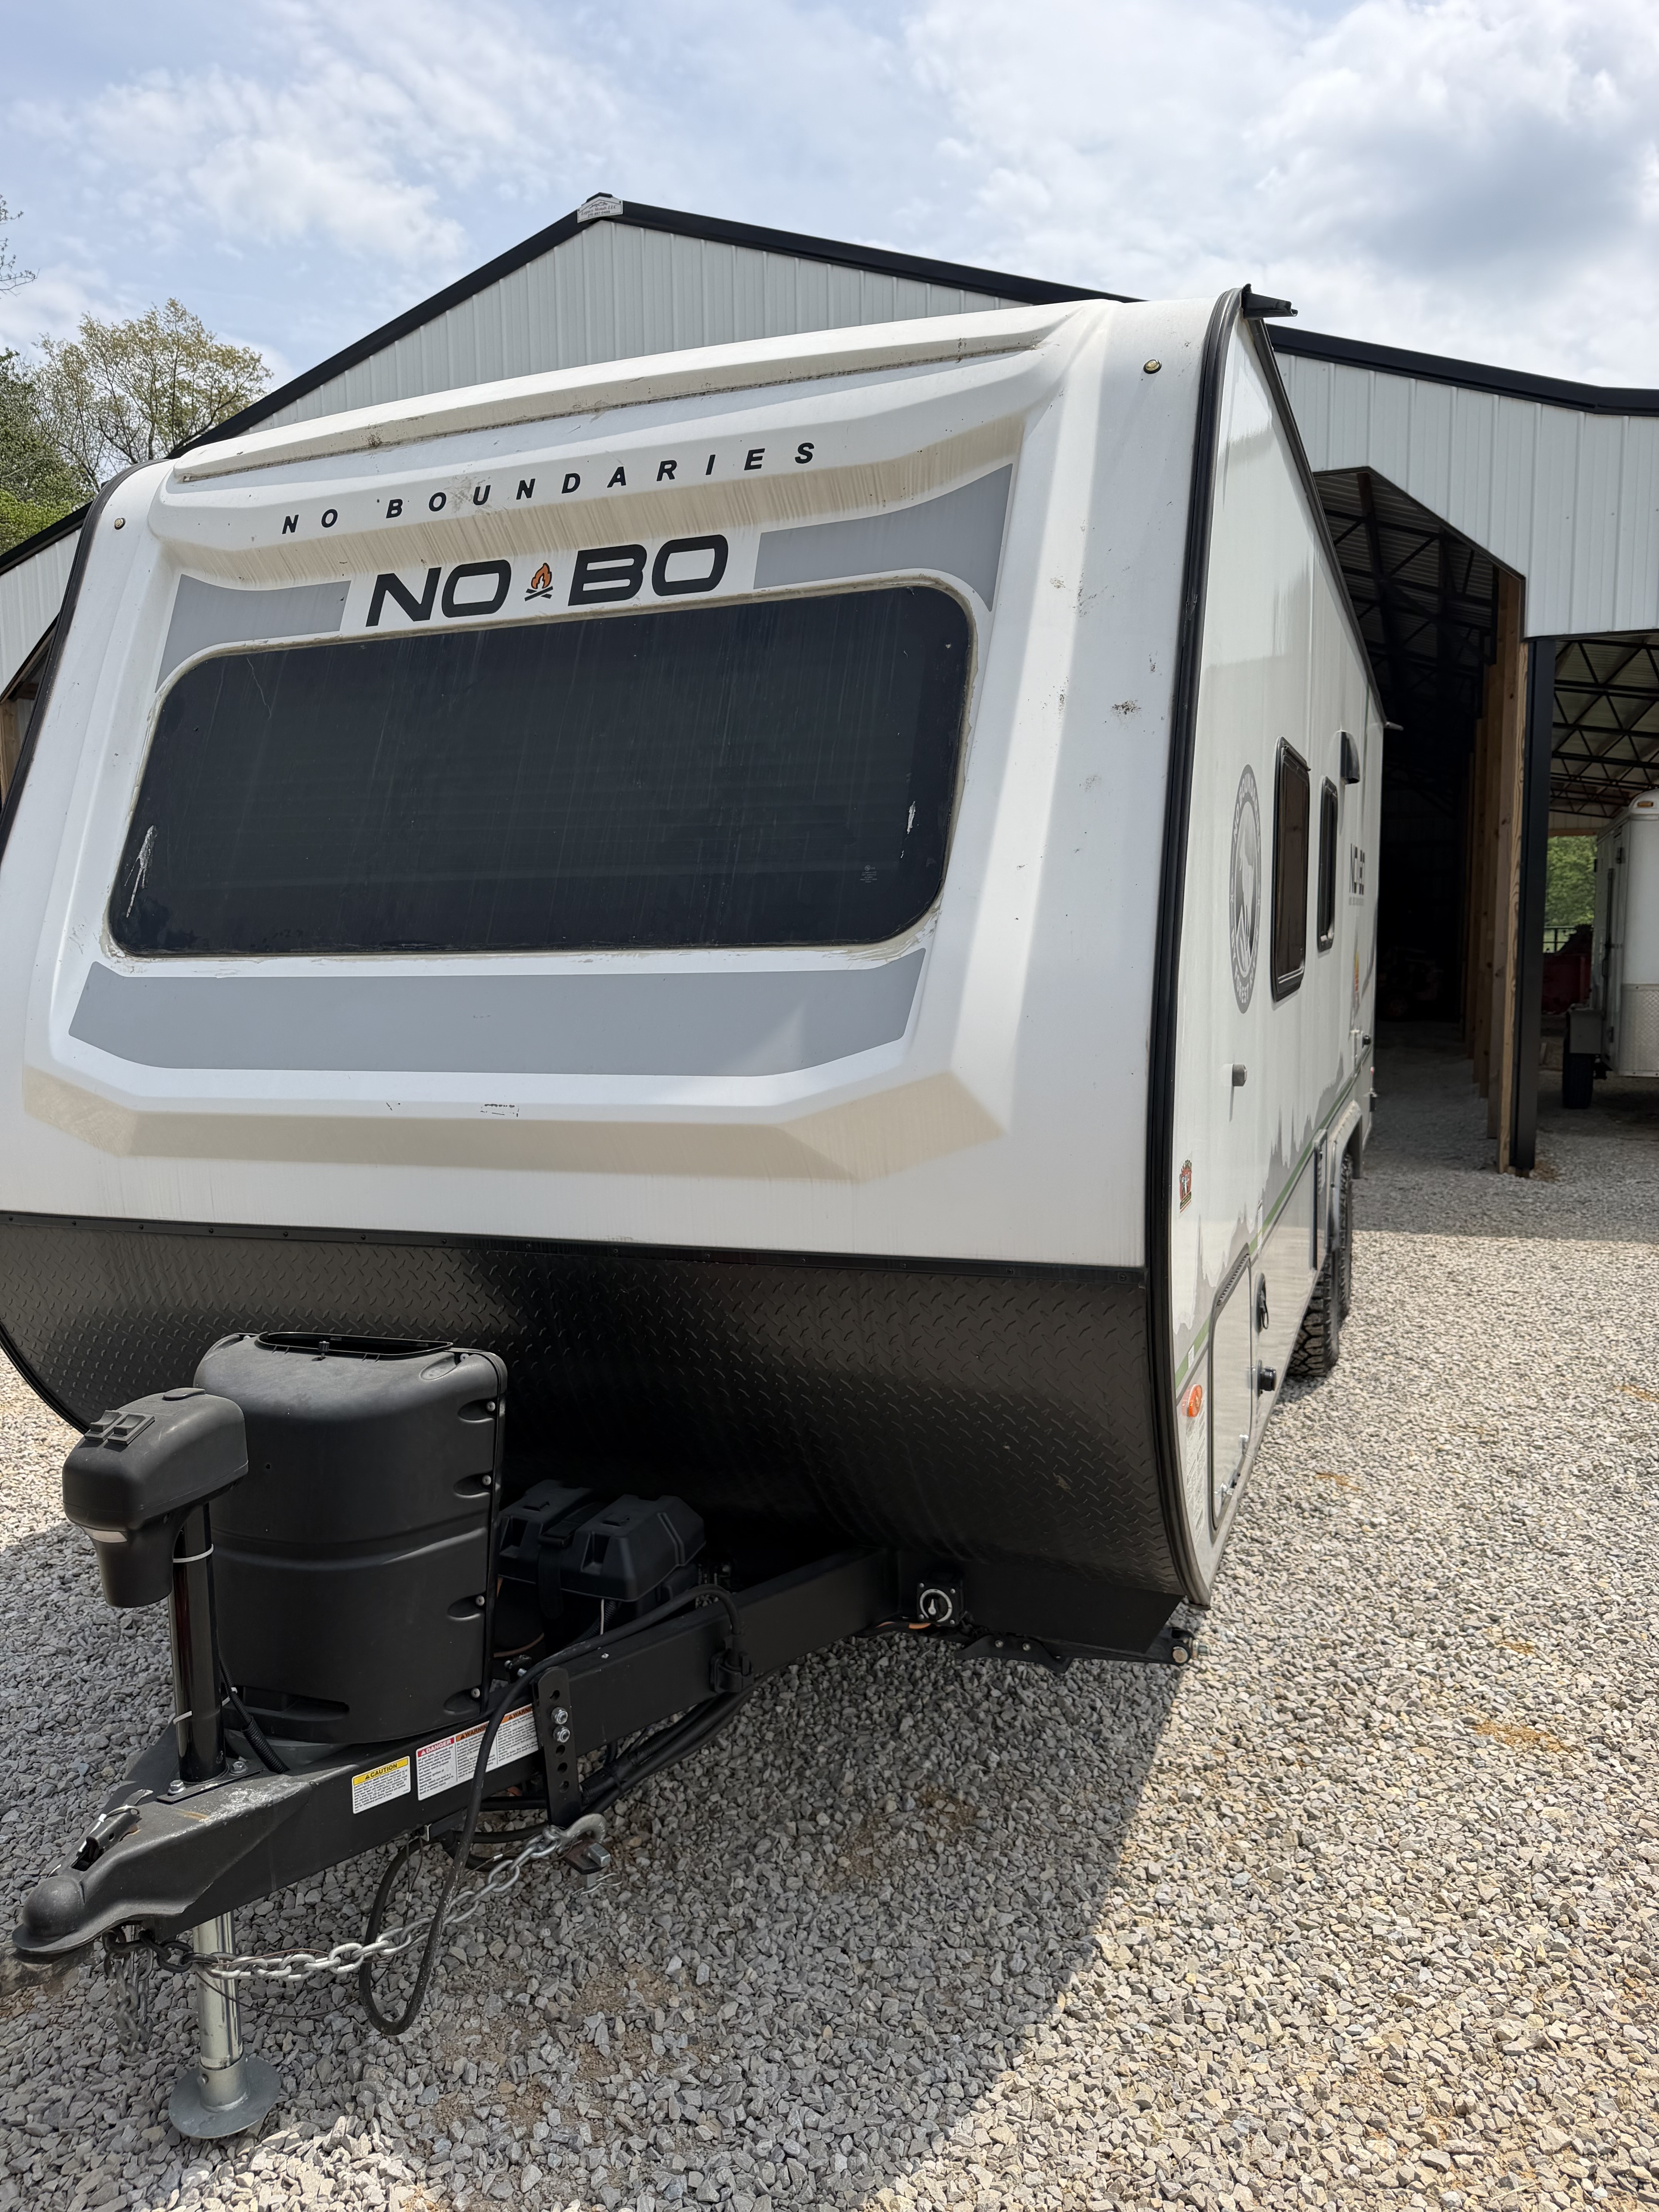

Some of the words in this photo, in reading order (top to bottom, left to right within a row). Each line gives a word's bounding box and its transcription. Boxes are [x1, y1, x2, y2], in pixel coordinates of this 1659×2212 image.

[282, 509, 338, 534] NO
[386, 443, 814, 519] BOUNDARIES
[366, 559, 512, 627] NO
[568, 534, 728, 606] BO
[370, 1763, 397, 1778] CAUTION
[426, 1739, 452, 1753] DANGER
